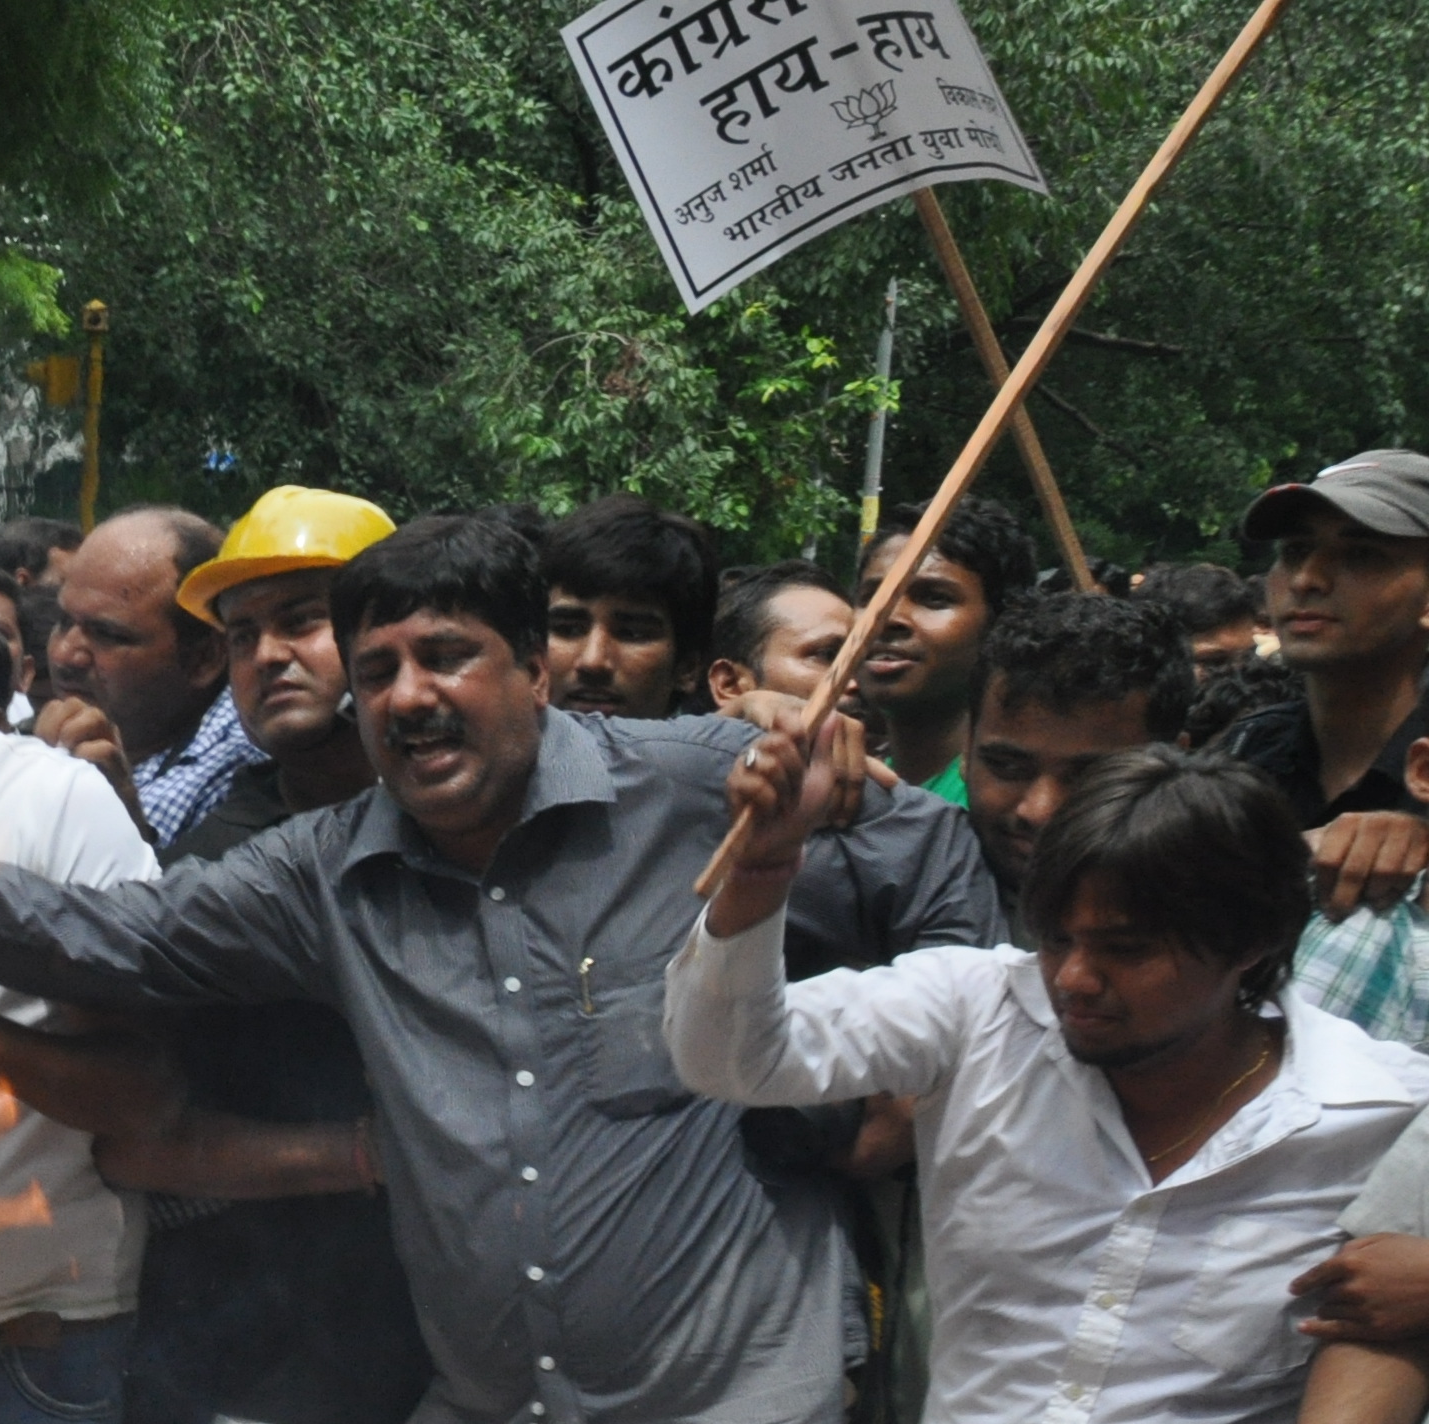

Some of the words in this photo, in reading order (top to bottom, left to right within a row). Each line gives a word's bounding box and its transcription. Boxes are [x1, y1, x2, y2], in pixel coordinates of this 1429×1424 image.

[673, 179, 728, 227] अनुज
[729, 143, 779, 190] शर्मा
[723, 176, 825, 241] भारतीय
[828, 134, 917, 183] जनता
[918, 127, 964, 160] युवा
